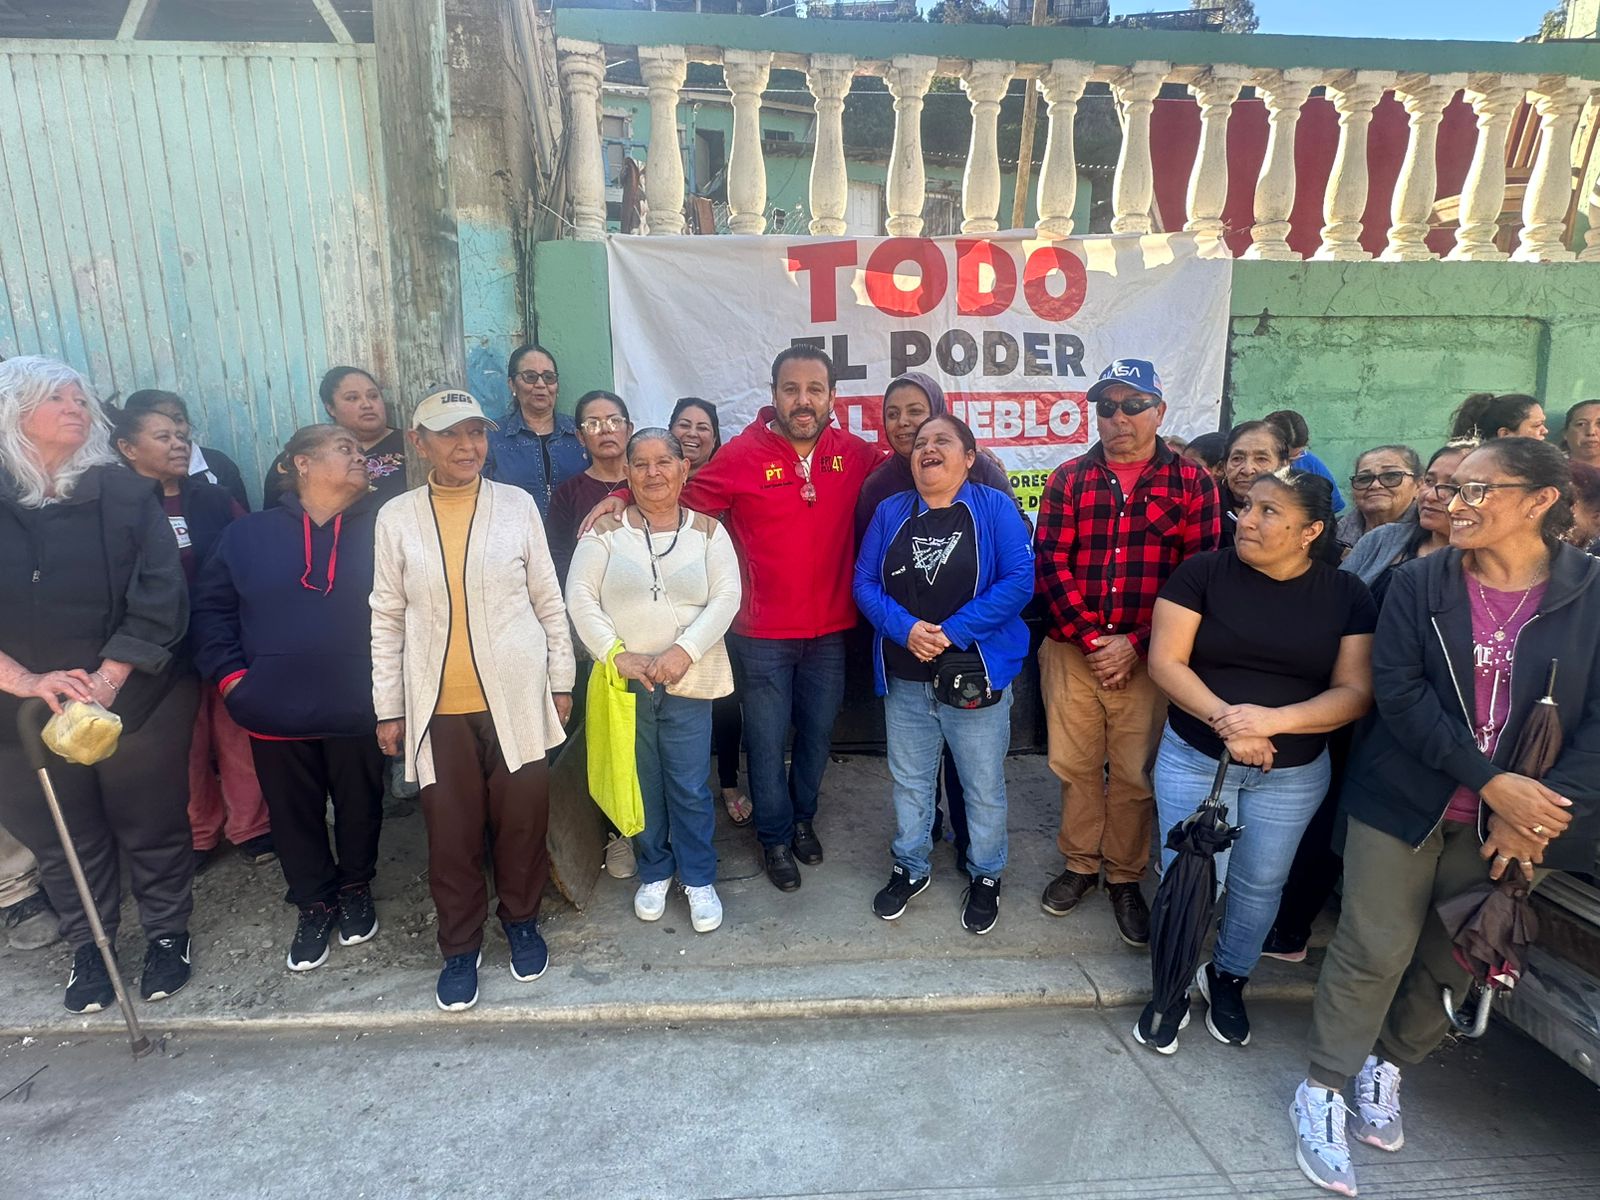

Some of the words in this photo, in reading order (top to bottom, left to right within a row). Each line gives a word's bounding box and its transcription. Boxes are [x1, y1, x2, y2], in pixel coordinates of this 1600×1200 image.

[787, 237, 1087, 323] TODO
[791, 334, 867, 380] L
[890, 329, 1086, 378] PODER
[953, 400, 1081, 438] EBLO
[766, 468, 783, 481] PT
[1010, 474, 1048, 488] ORES
